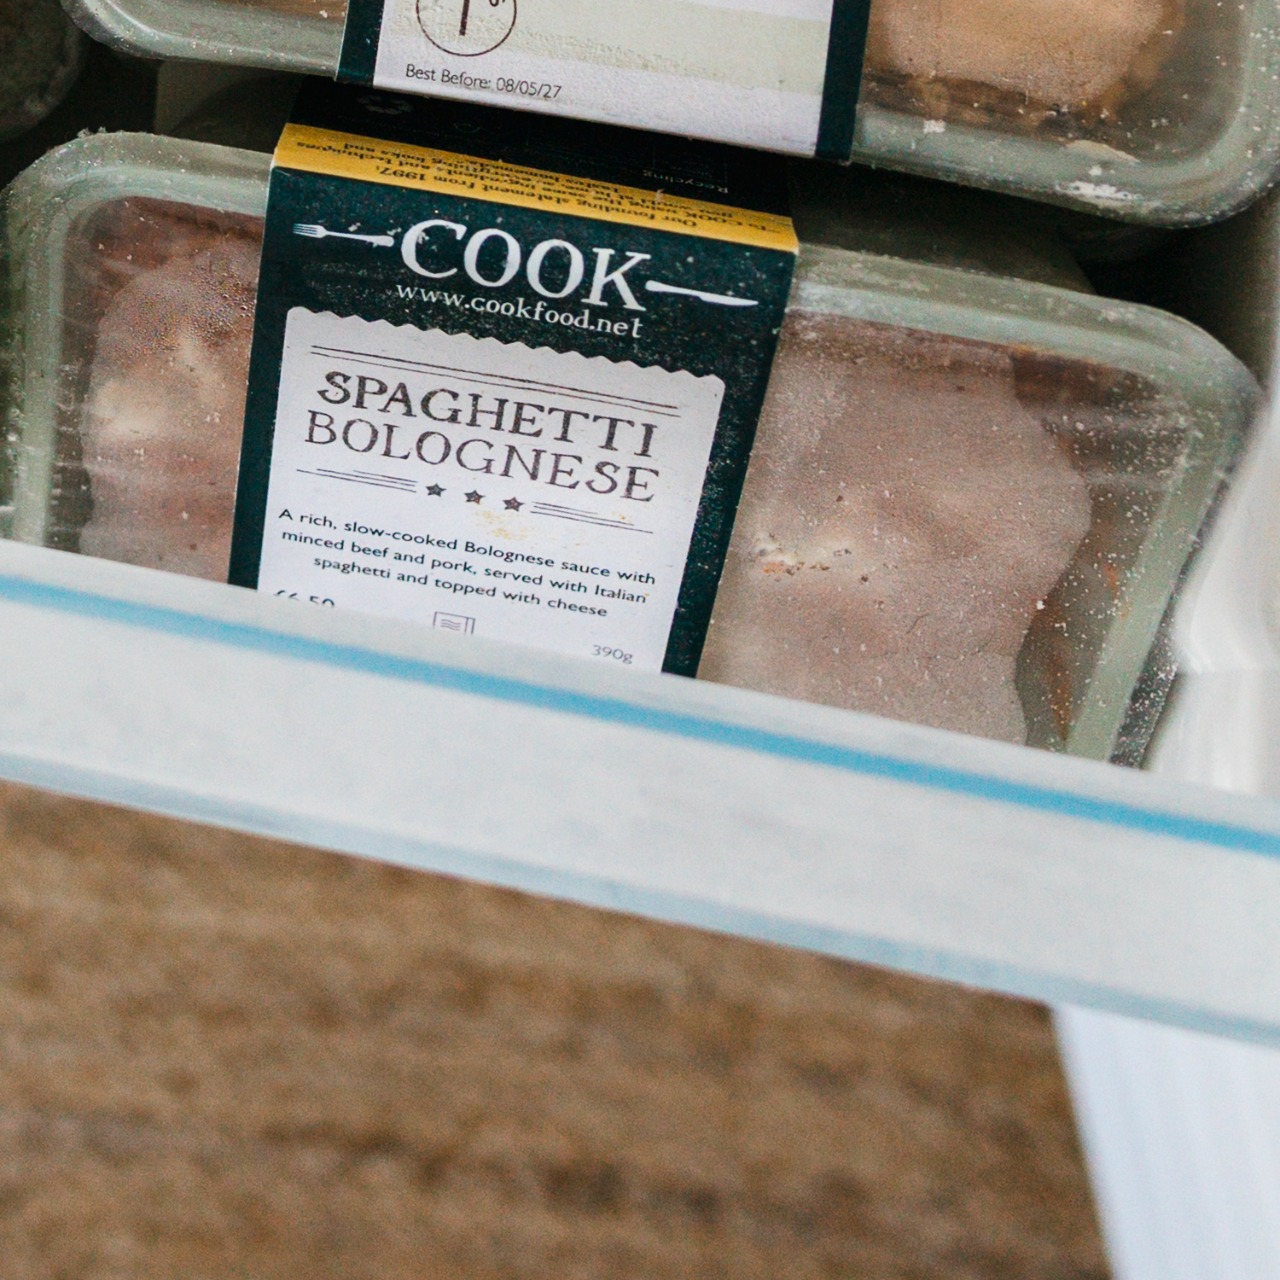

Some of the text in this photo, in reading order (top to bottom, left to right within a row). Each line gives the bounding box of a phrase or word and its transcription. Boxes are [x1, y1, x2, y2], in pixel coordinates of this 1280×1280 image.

[406, 64, 562, 101] Best Before: 08/05/27
[400, 219, 651, 313] COOK
[397, 282, 641, 338] www.cookfood.net
[317, 370, 658, 458] SPAGHETTI
[305, 409, 660, 502] BOLOGNESE
[279, 509, 293, 520] A
[345, 522, 457, 550] slow-cooked
[465, 541, 554, 567] Bolognese
[562, 562, 610, 577] sauce
[617, 572, 655, 584] with
[282, 532, 344, 550] minced
[351, 542, 389, 557] beef
[394, 553, 425, 564] and
[485, 568, 543, 585] served
[550, 580, 587, 593] with
[595, 585, 646, 603] Italian
[315, 558, 607, 616] spaghetti and topped with cheese
[591, 644, 633, 665] 390g
